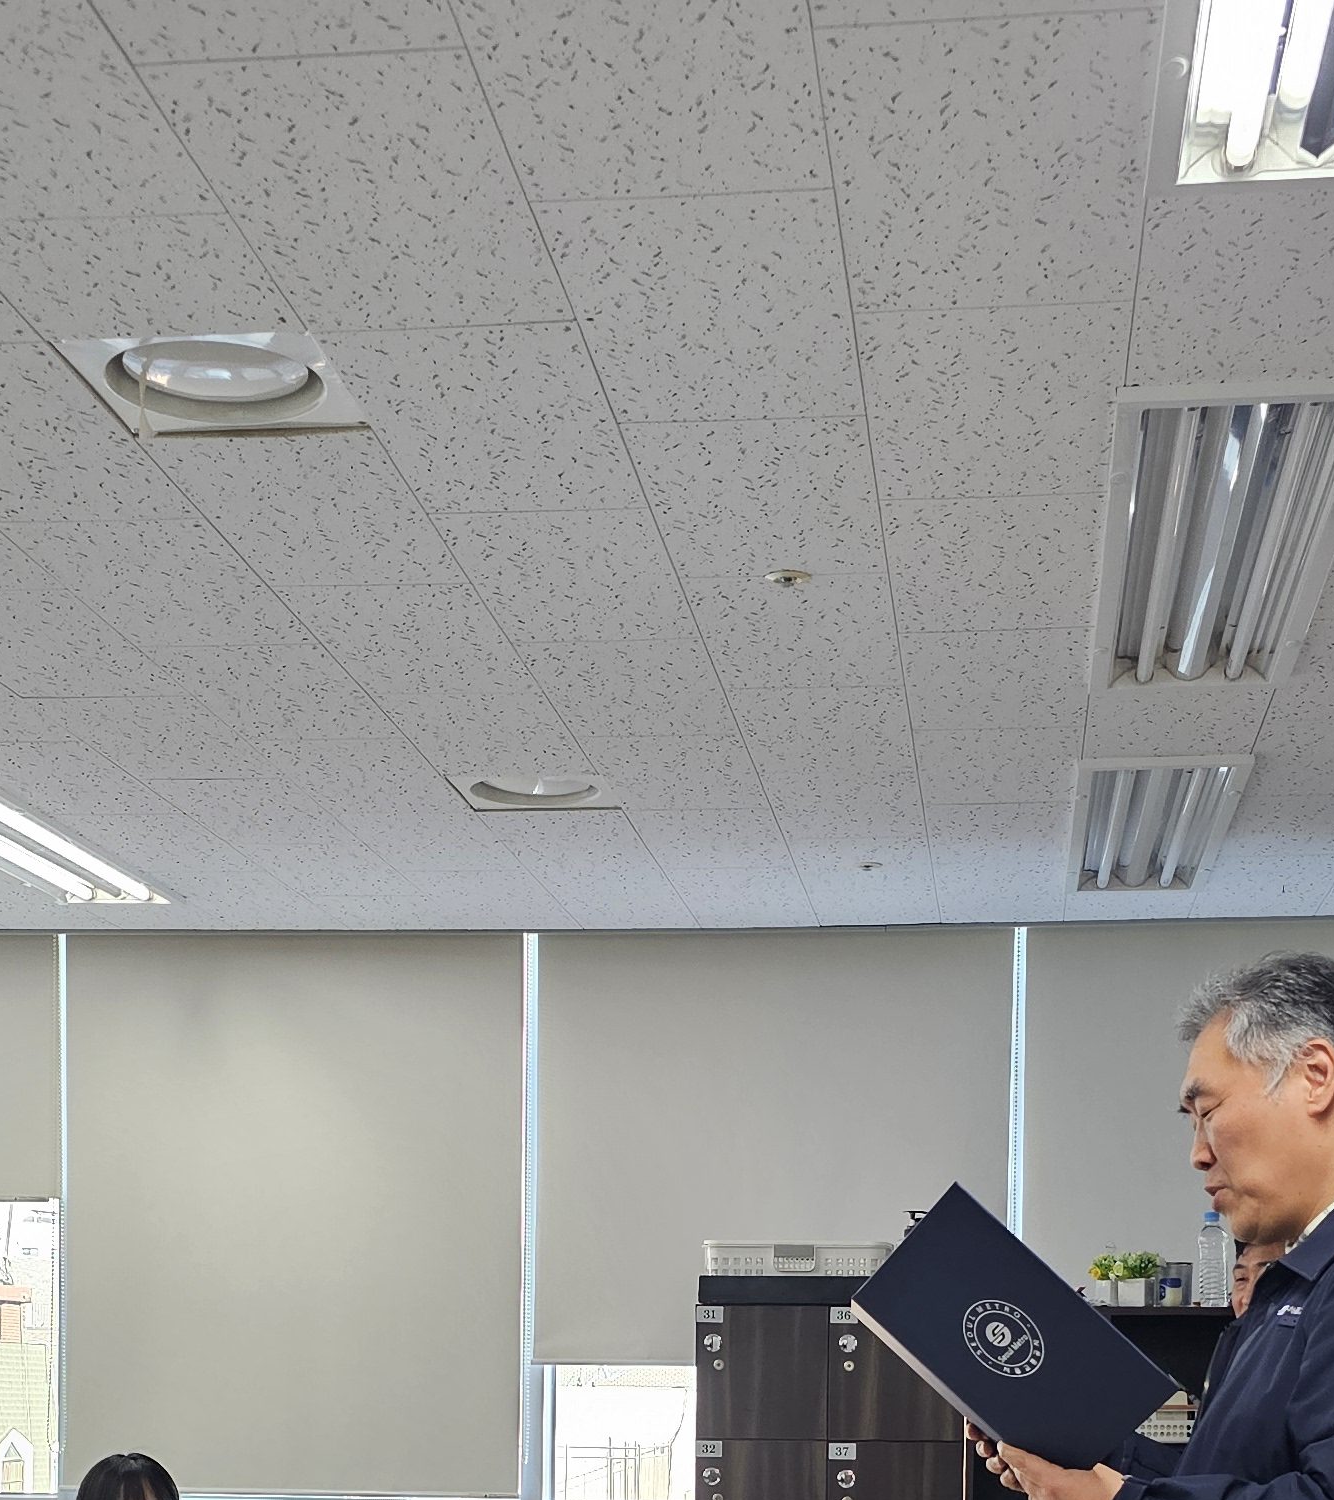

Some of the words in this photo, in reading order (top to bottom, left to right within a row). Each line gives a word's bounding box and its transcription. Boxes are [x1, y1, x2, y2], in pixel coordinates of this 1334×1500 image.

[703, 1309, 716, 1319] 31
[836, 1310, 851, 1320] 36
[701, 1444, 716, 1454] 32
[835, 1446, 849, 1457] 37
